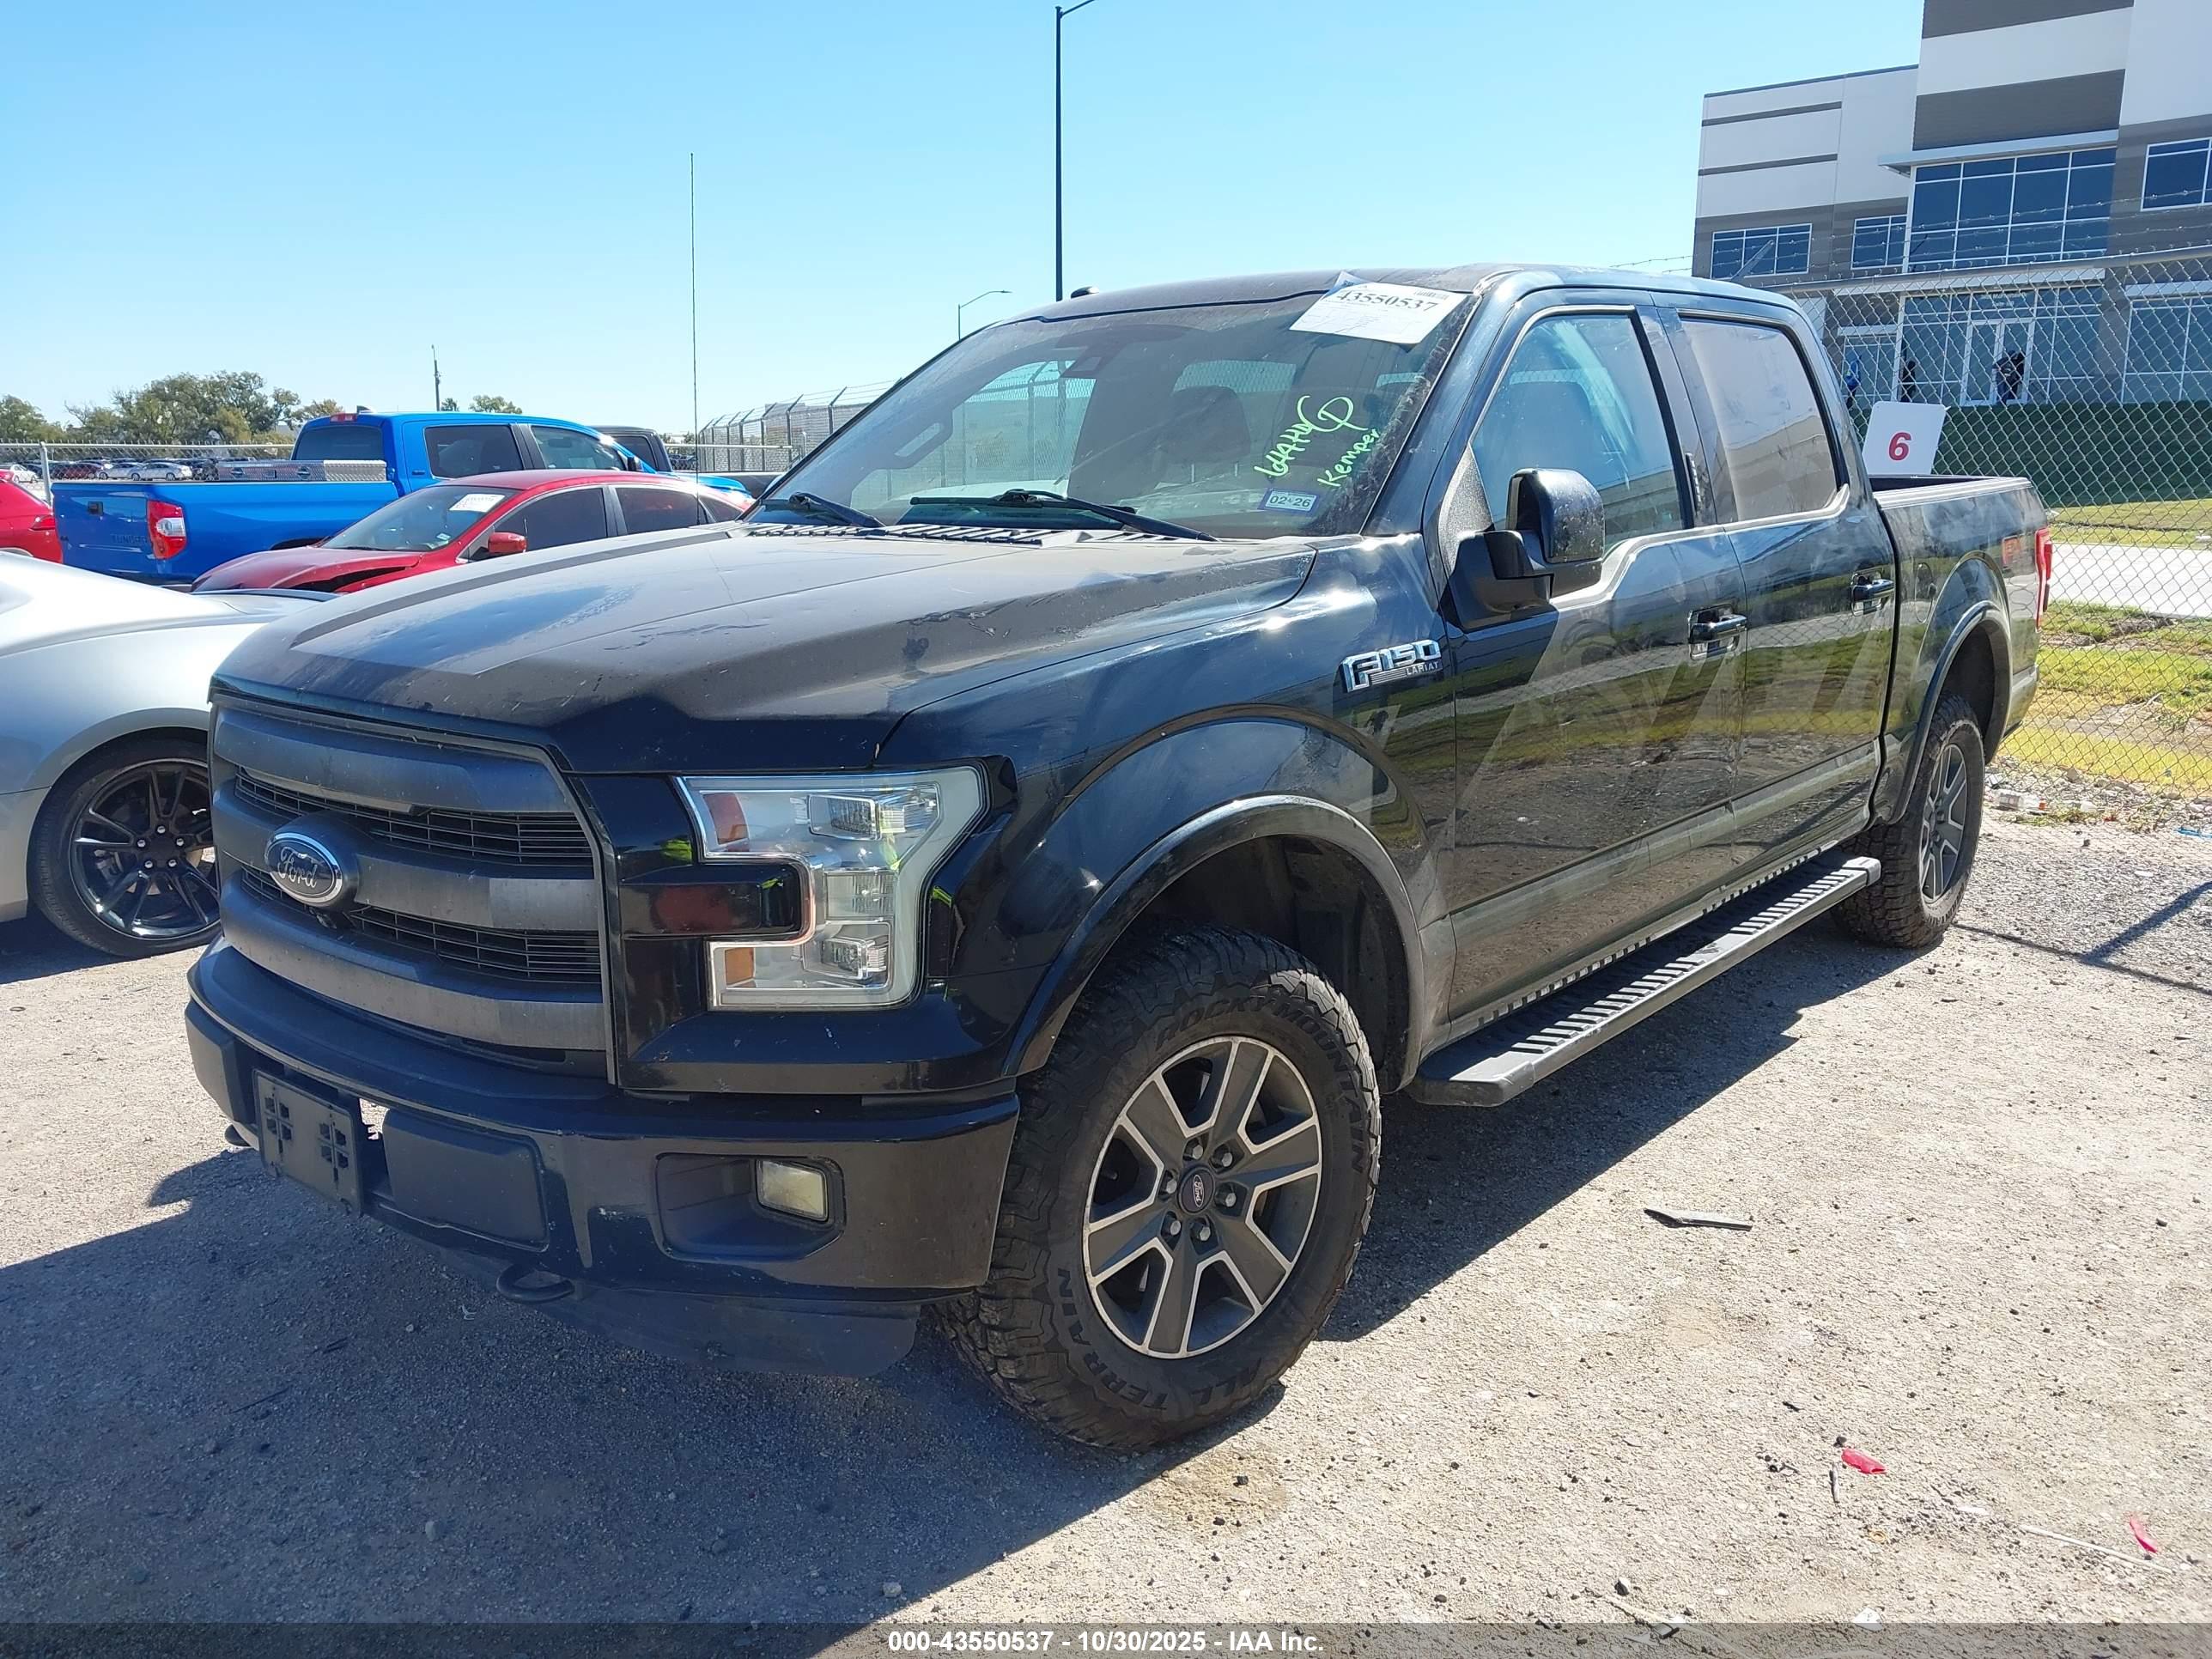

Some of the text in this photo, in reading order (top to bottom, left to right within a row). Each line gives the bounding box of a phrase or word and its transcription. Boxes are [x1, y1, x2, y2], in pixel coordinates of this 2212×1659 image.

[1337, 289, 1438, 312] 43550537
[1316, 428, 1381, 487] Kemper
[1888, 432, 1912, 461] 6
[1406, 660, 1440, 676] LARIAT
[276, 846, 326, 889] Ford
[1271, 1001, 1367, 1176] MOUNTAIN
[1056, 1267, 1170, 1413] TERRAIN
